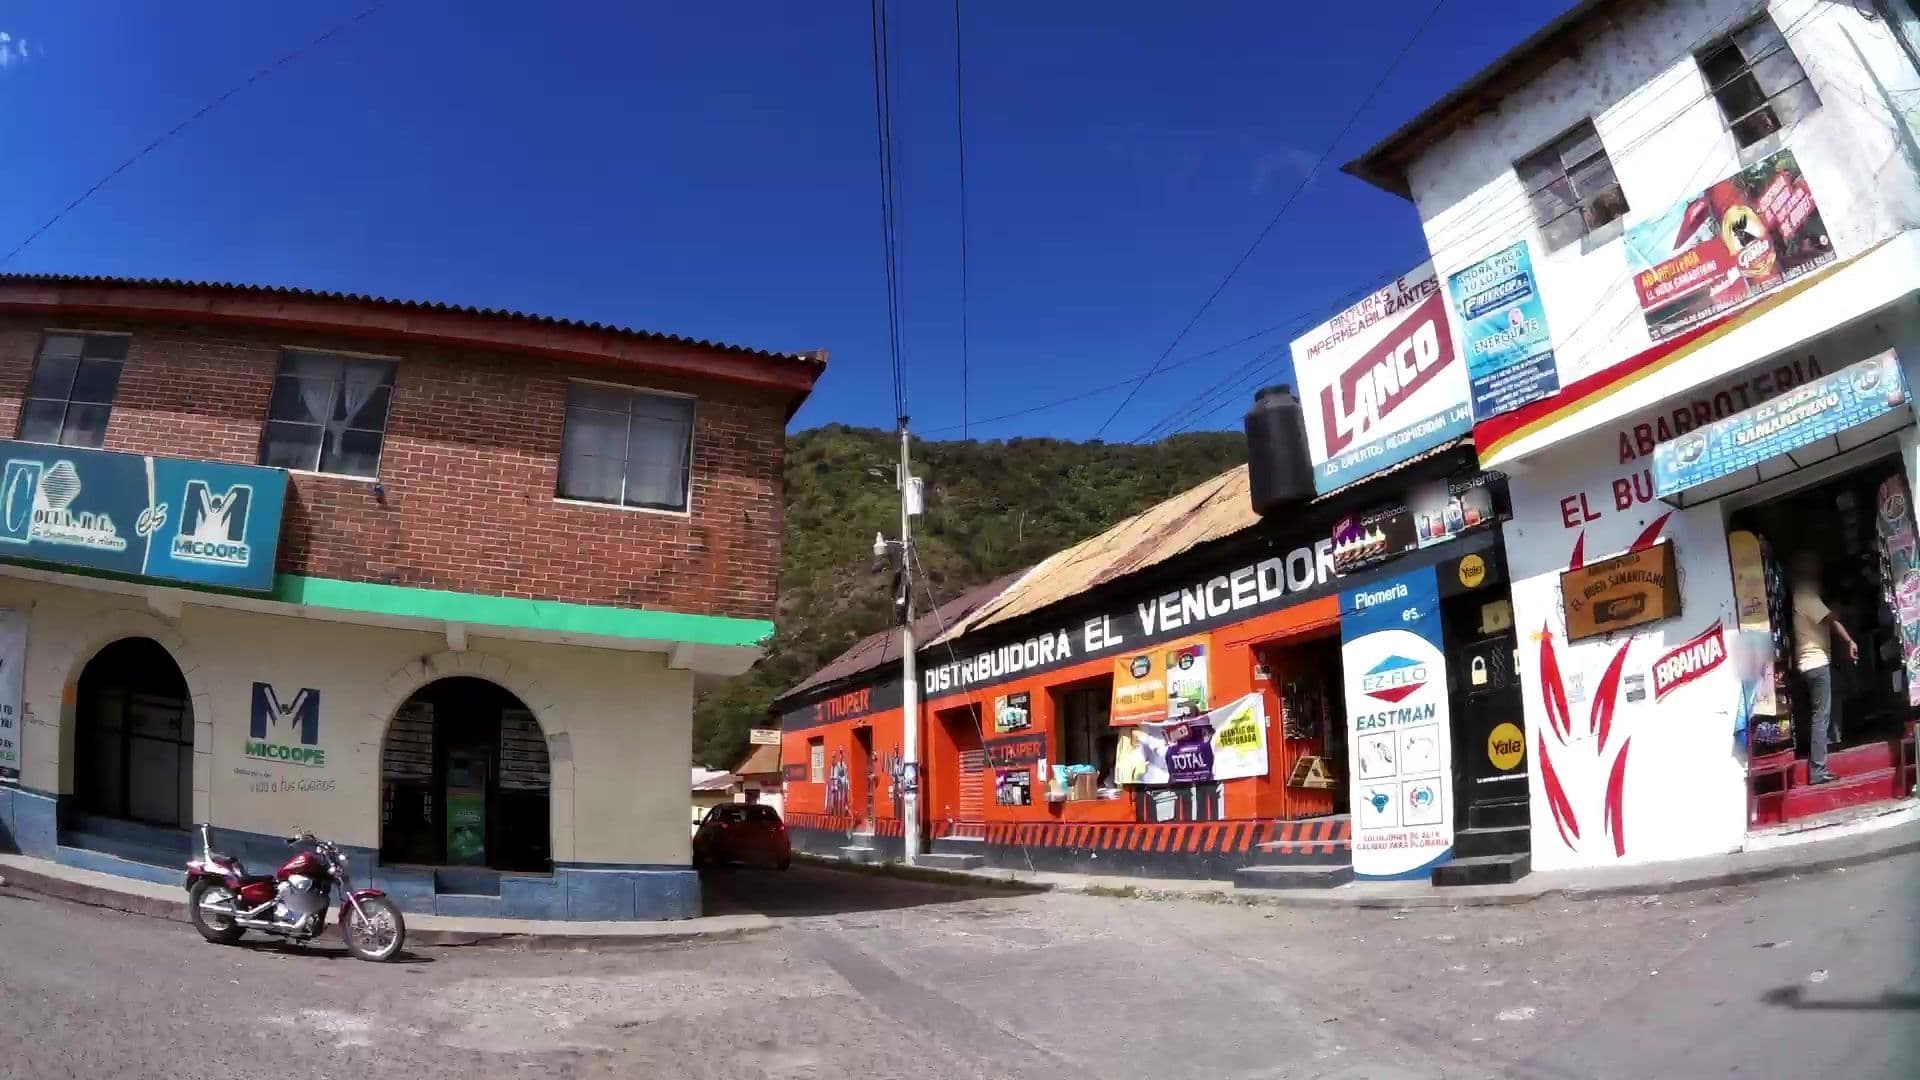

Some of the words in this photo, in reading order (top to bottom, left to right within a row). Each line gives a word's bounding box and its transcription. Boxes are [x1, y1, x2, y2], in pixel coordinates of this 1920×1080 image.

[1306, 277, 1439, 360] IMPERMEABILIZANTES
[1329, 288, 1390, 333] PINTURAS
[1397, 277, 1409, 292] E
[1331, 319, 1440, 440] LANCO
[1559, 491, 1602, 529] EL
[174, 540, 250, 561] MICOOPE
[924, 629, 1072, 694] DISTRIBUIDORA
[1084, 615, 1123, 653] EL
[1138, 541, 1345, 637] VENCEDOR
[1656, 634, 1723, 686] BRAHVA
[1363, 667, 1427, 691] EZ-FLO
[1356, 703, 1436, 731] EASTMAN
[245, 742, 324, 765] MICOOPE
[1171, 752, 1207, 770] TOTAL
[1492, 739, 1523, 757] Yale
